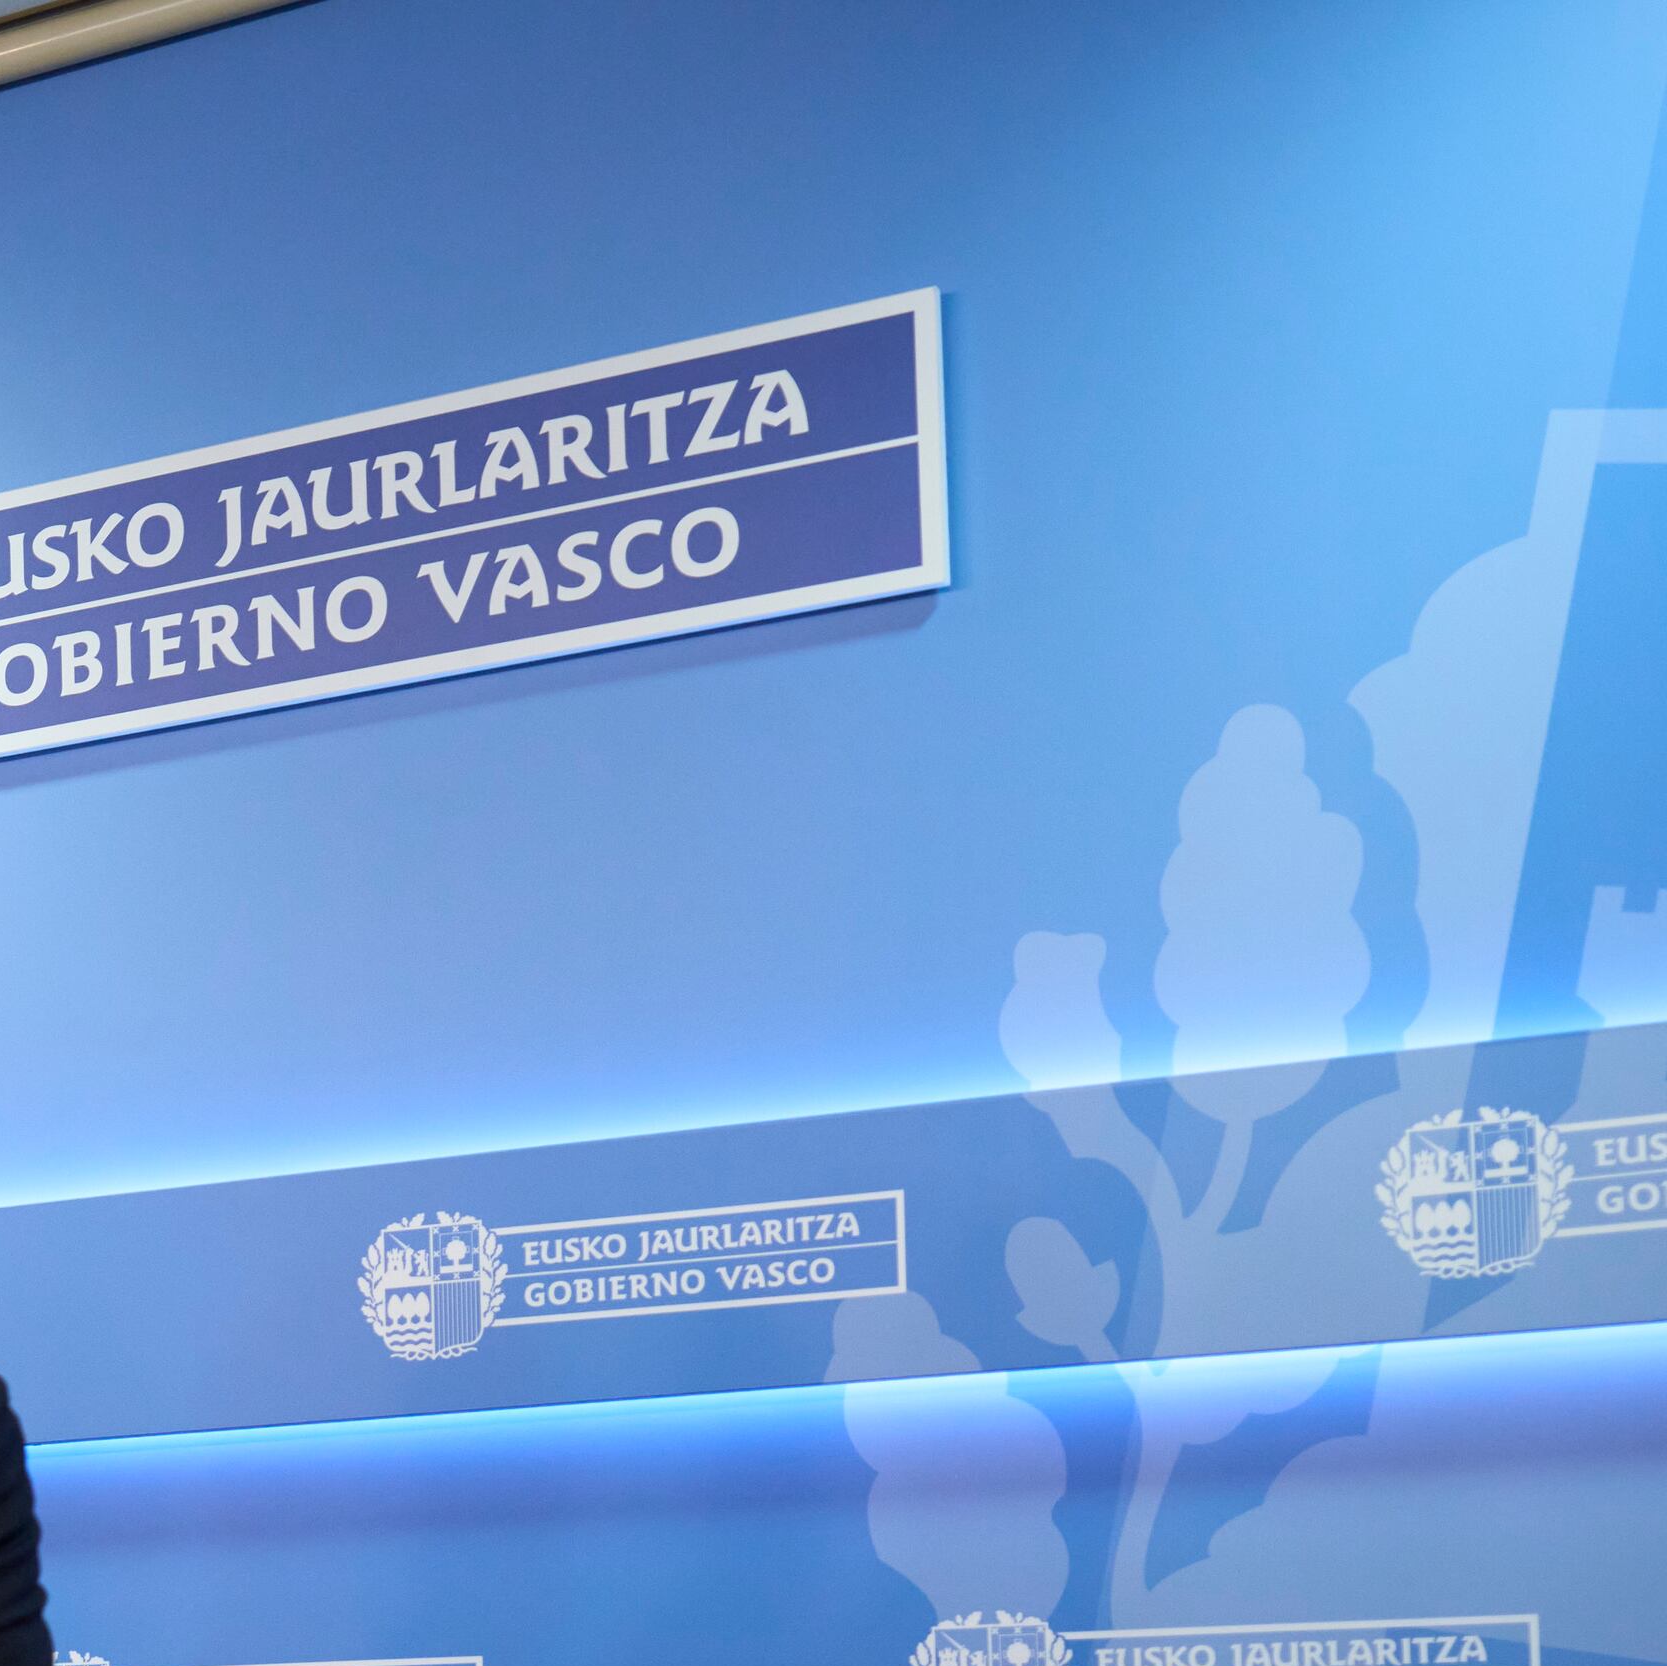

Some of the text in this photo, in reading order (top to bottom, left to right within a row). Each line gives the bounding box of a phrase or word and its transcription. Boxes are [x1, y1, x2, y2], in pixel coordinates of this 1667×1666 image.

[215, 369, 809, 567] JAURLARITZA
[417, 506, 741, 623] VASCO
[1592, 1132, 1667, 1167] EUS
[522, 1212, 860, 1266] EUSKO JAURLARITZA
[524, 1257, 835, 1307] GOBIERNO VASCO
